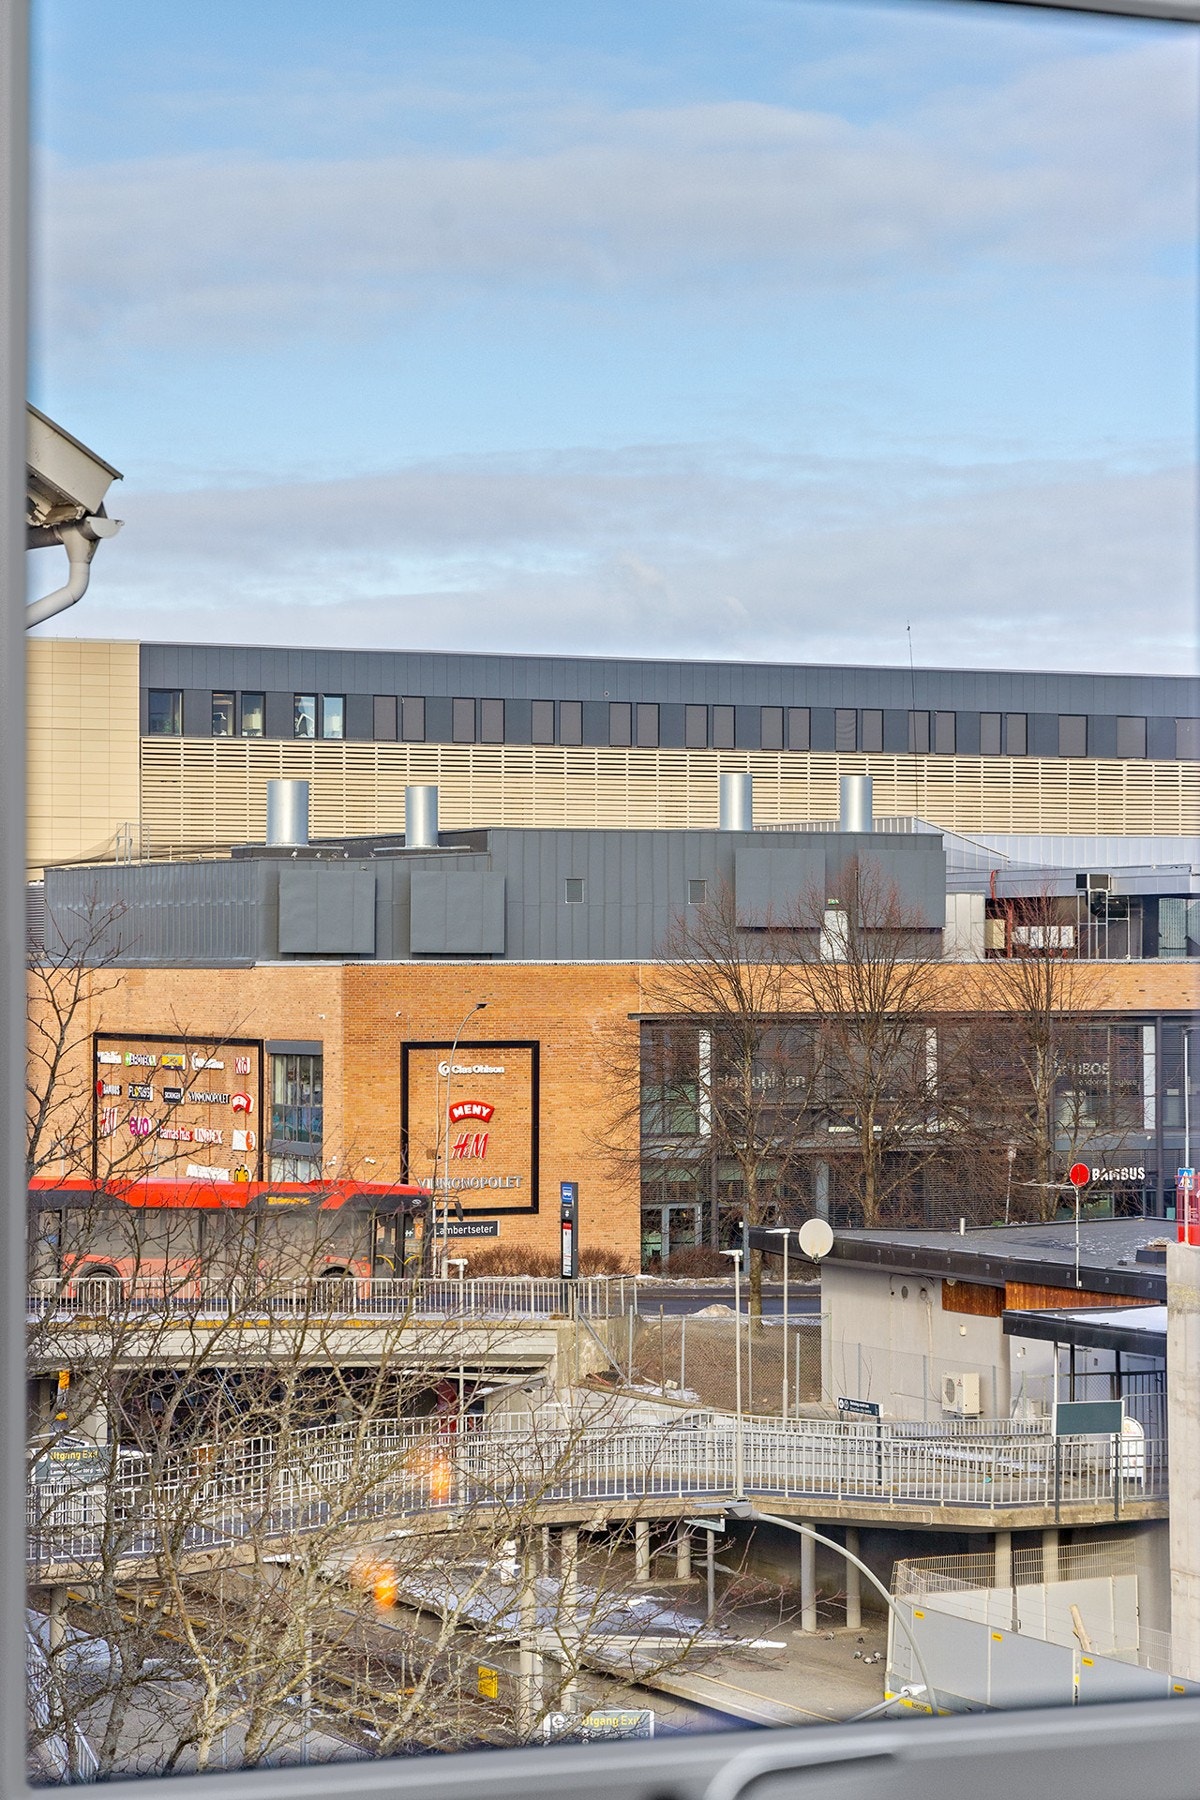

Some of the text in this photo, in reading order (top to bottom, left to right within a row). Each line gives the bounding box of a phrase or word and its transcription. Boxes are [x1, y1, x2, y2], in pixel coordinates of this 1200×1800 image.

[451, 1065, 505, 1073] Clas Ohlson
[453, 1104, 490, 1118] MENY
[130, 1117, 150, 1136] evo
[451, 1132, 489, 1160] H&M
[1091, 1167, 1146, 1180] BAMBUS
[418, 1177, 522, 1190] VINMONOPOLET
